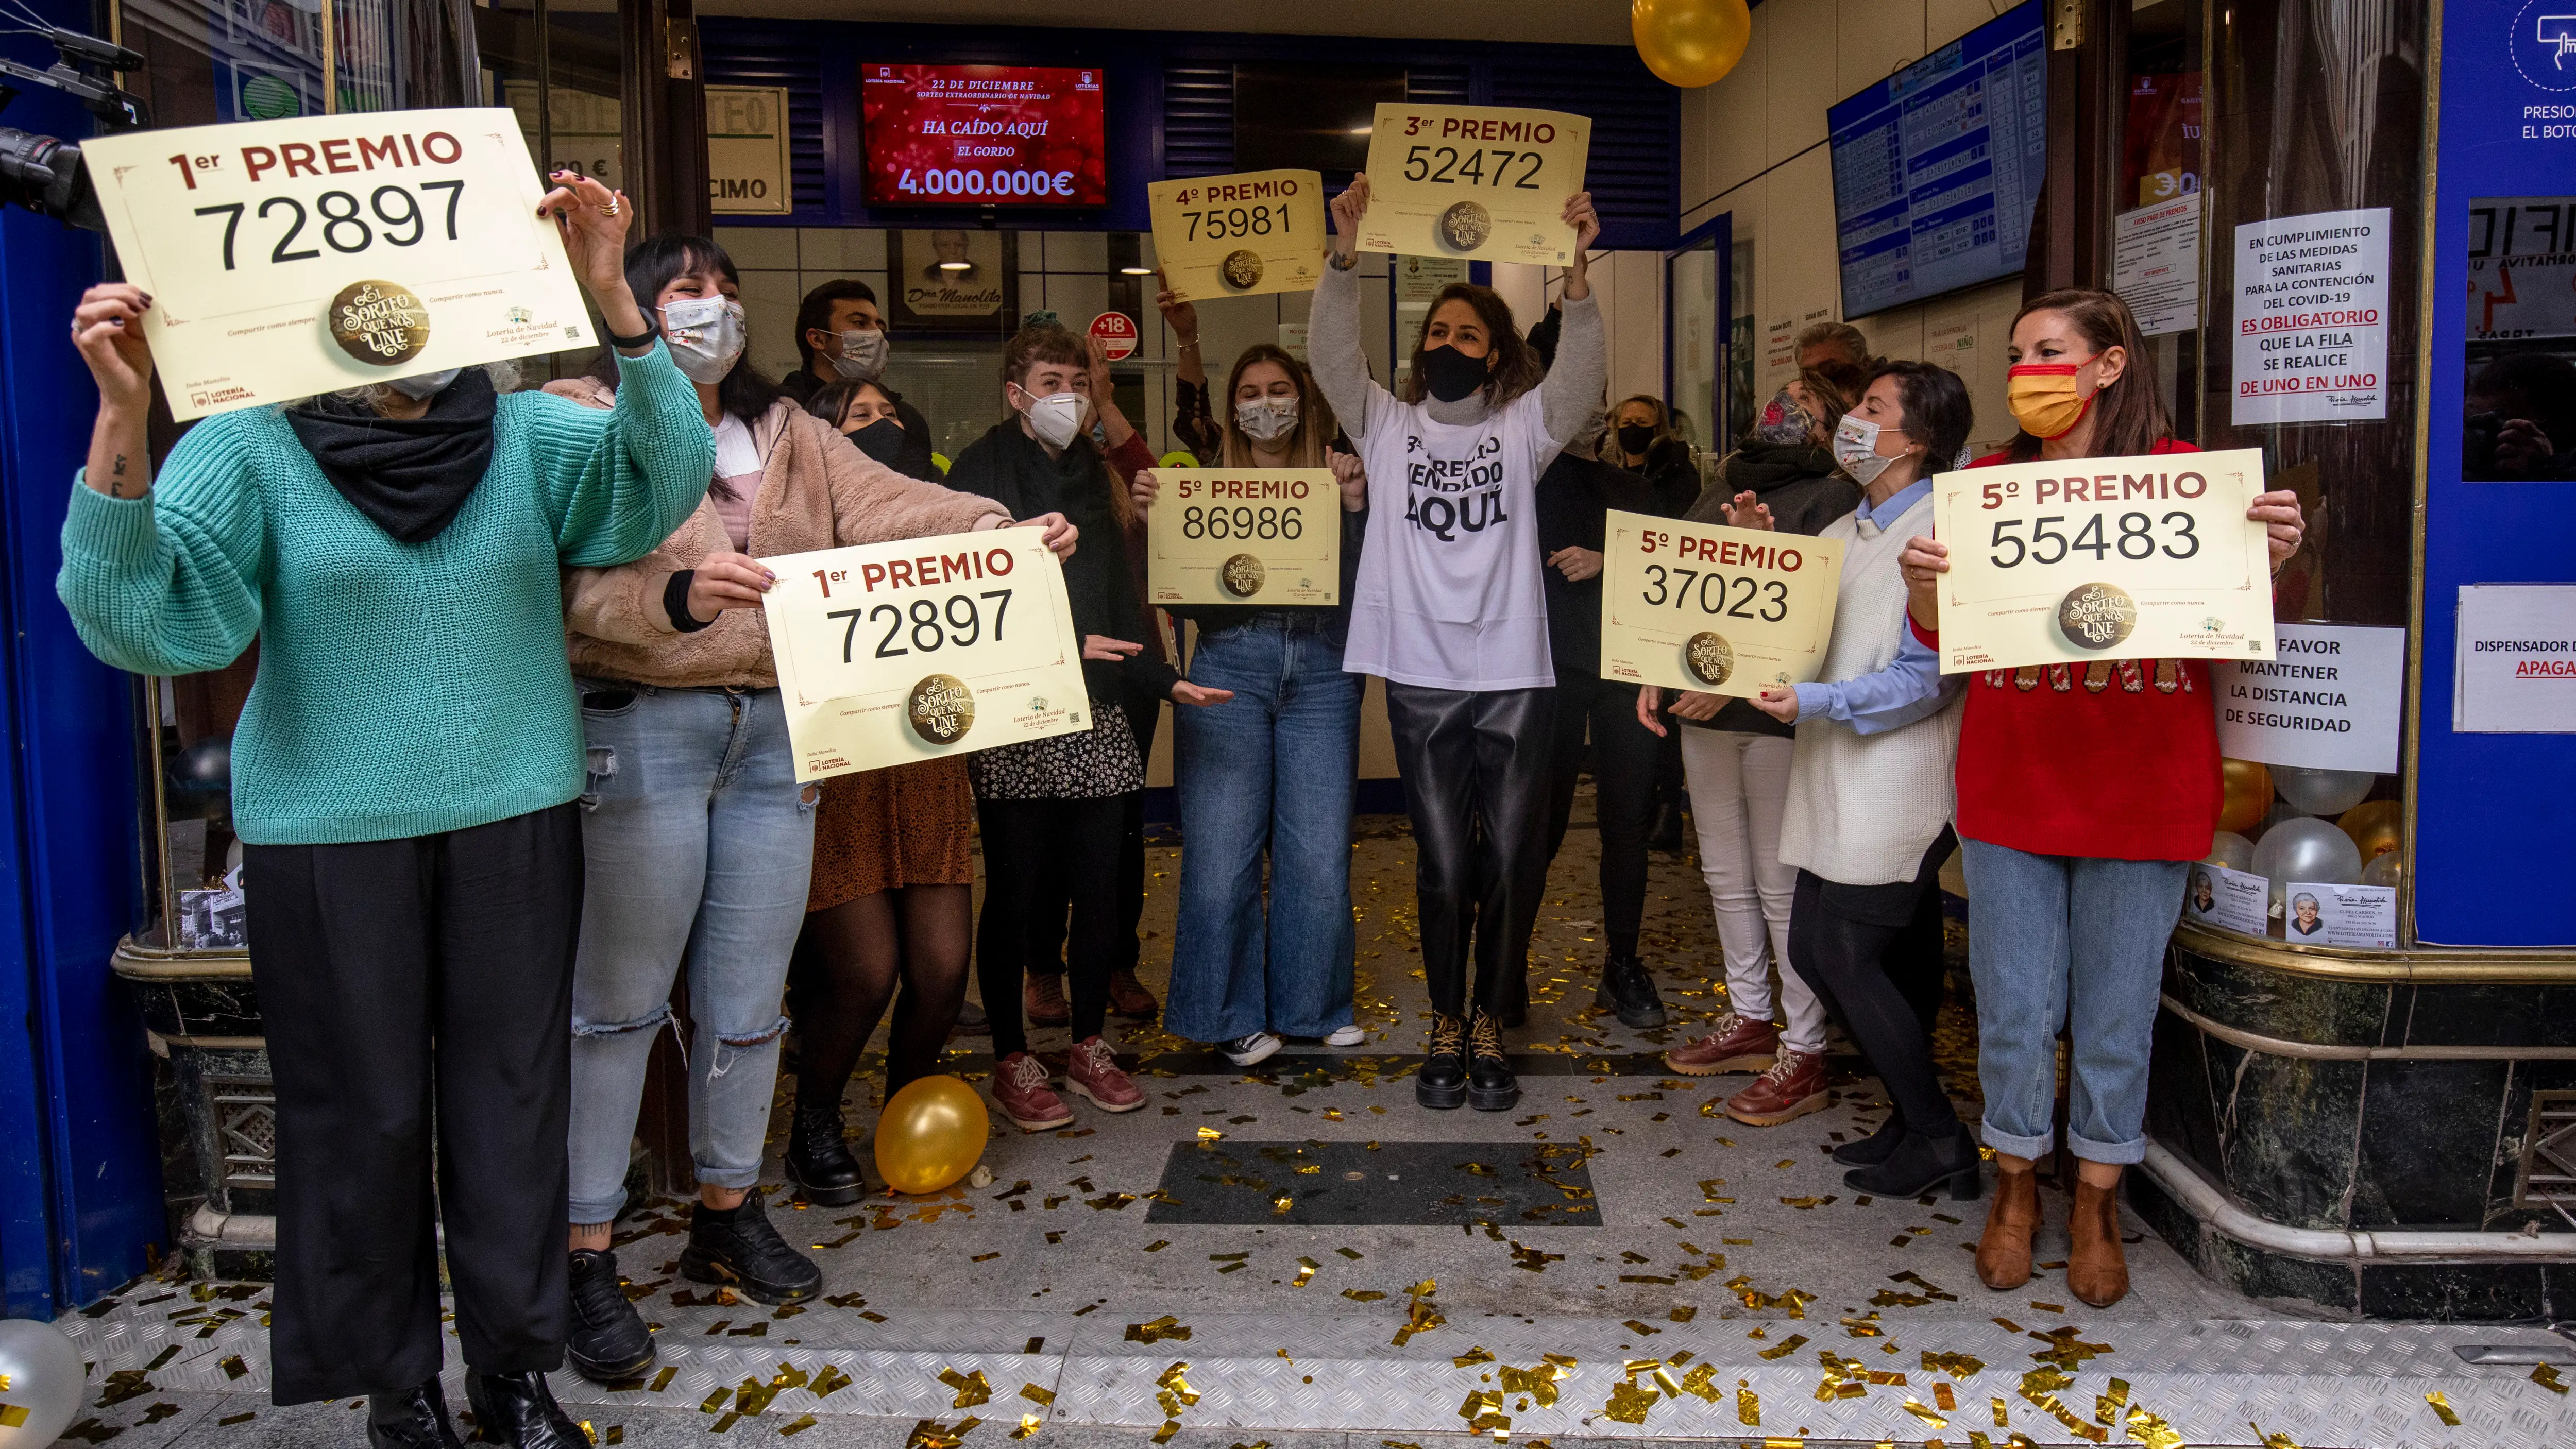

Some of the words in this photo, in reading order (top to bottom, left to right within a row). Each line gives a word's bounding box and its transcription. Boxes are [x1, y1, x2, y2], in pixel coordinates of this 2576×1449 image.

[950, 80, 964, 89] DE
[969, 81, 1033, 90] DICIEMBRE
[2524, 106, 2576, 118] PRESIO
[922, 121, 945, 133] HA
[951, 118, 1003, 134] CAÍDO
[1005, 120, 1048, 139] AQUÍ
[1404, 117, 1434, 136] 3er
[1443, 118, 1555, 143] PREMIO
[2523, 126, 2538, 138] EL
[958, 147, 971, 156] EL
[974, 147, 1014, 156] GORDO
[169, 154, 219, 190] 1er
[241, 132, 462, 182] PREMIO
[1404, 146, 1543, 189] 52472
[899, 169, 1074, 195] 4.000.000€
[1176, 189, 1198, 205] 4º
[1208, 180, 1297, 202] PREMIO
[1459, 203, 1474, 214] EL
[2133, 215, 2146, 226] AVISO
[2147, 212, 2158, 223] PAGO
[2158, 211, 2165, 219] DE
[2166, 205, 2187, 217] PREMIOS
[194, 180, 464, 270] 72897
[1182, 203, 1289, 241] 75981
[1449, 211, 1485, 227] SORTEO
[1458, 224, 1469, 232] QUE
[1470, 223, 1483, 232] NOS
[1453, 231, 1476, 246] UNE
[2250, 238, 2263, 249] EN
[2267, 226, 2371, 247] CUMPLIMIENTO
[1235, 252, 1248, 261] EL
[2260, 253, 2273, 263] DE
[2277, 250, 2296, 261] LAS
[2300, 244, 2357, 258] MEDIDAS
[1228, 256, 1257, 272] SORTEO
[1248, 265, 1258, 273] NOS
[2272, 261, 2341, 277] SANITARIAS
[1233, 272, 1252, 285] UNE
[2246, 284, 2272, 295] PARA
[2276, 282, 2288, 292] LA
[2291, 272, 2375, 291] CONTENCIÓN
[354, 285, 383, 306] EL
[939, 288, 1001, 303] Manolita
[2264, 298, 2284, 309] DEL
[2288, 293, 2350, 306] COVID-19
[343, 294, 409, 331] SORTEO
[1817, 309, 1827, 317] BOTE
[2242, 319, 2256, 332] ES
[2261, 309, 2379, 331] OBLIGATORIO
[363, 318, 387, 332] QUE
[389, 311, 415, 328] NOS
[527, 320, 557, 331] Navidad
[1099, 318, 1125, 332] +18
[360, 329, 408, 356] UNE
[1957, 335, 1973, 349] NIÑO
[2260, 337, 2290, 351] QUE
[2296, 336, 2314, 347] LA
[2320, 333, 2353, 348] FILA
[2264, 359, 2279, 370] SE
[2284, 354, 2347, 369] REALICE
[211, 388, 245, 398] LOTERÍA
[2241, 381, 2258, 394] DE
[2263, 378, 2302, 395] UNO
[2307, 376, 2328, 389] EN
[2335, 374, 2376, 387] UNO
[213, 390, 254, 403] NACIONAL
[1179, 481, 1201, 498] 5º
[1212, 481, 1309, 499] PREMIO
[1982, 482, 2019, 509] 5º
[2036, 472, 2207, 504] PREMIO
[1404, 484, 1507, 542] AQUÍ
[1183, 506, 1302, 539] 86986
[1991, 512, 2199, 568] 55483
[1641, 530, 1668, 553] 5º
[1679, 536, 1803, 572] PREMIO
[1229, 562, 1259, 577] SORTEO
[1236, 556, 1249, 566] EL
[812, 570, 847, 598] 1er
[862, 549, 1013, 592] PREMIO
[1247, 571, 1259, 580] NOS
[1233, 578, 1252, 593] UNE
[1643, 564, 1788, 622] 37023
[2082, 586, 2104, 601] EL
[2070, 595, 2125, 620] SORTEO
[2083, 613, 2103, 623] QUE
[2104, 609, 2124, 622] NOS
[827, 589, 1012, 663] 72897
[2078, 621, 2114, 643] UNE
[1701, 635, 1716, 646] EL
[2279, 639, 2340, 654] FAVOR
[2476, 641, 2568, 652] DISPENSADOR
[1692, 643, 1727, 659] SORTEO
[1701, 655, 1713, 665] QUE
[1714, 655, 1726, 667] NOS
[2240, 660, 2337, 679] MANTENER
[2516, 661, 2576, 675] APAGA
[1698, 662, 1720, 680] UNE
[927, 678, 946, 695] EL
[918, 687, 962, 715] SORTEO
[2231, 685, 2247, 698] LA
[2252, 687, 2347, 706] DISTANCIA
[882, 704, 903, 712] siempre.
[930, 708, 946, 718] QUE
[948, 701, 965, 714] NOS
[1014, 715, 1033, 724] Lotería
[1041, 707, 1065, 717] Navidad
[927, 714, 958, 737] UNE
[1036, 718, 1058, 727] diciembre
[2226, 709, 2243, 722] DE
[2248, 712, 2350, 732] SEGURIDAD
[822, 758, 844, 766] LOTERÍA
[822, 760, 851, 770] NACIONAL
